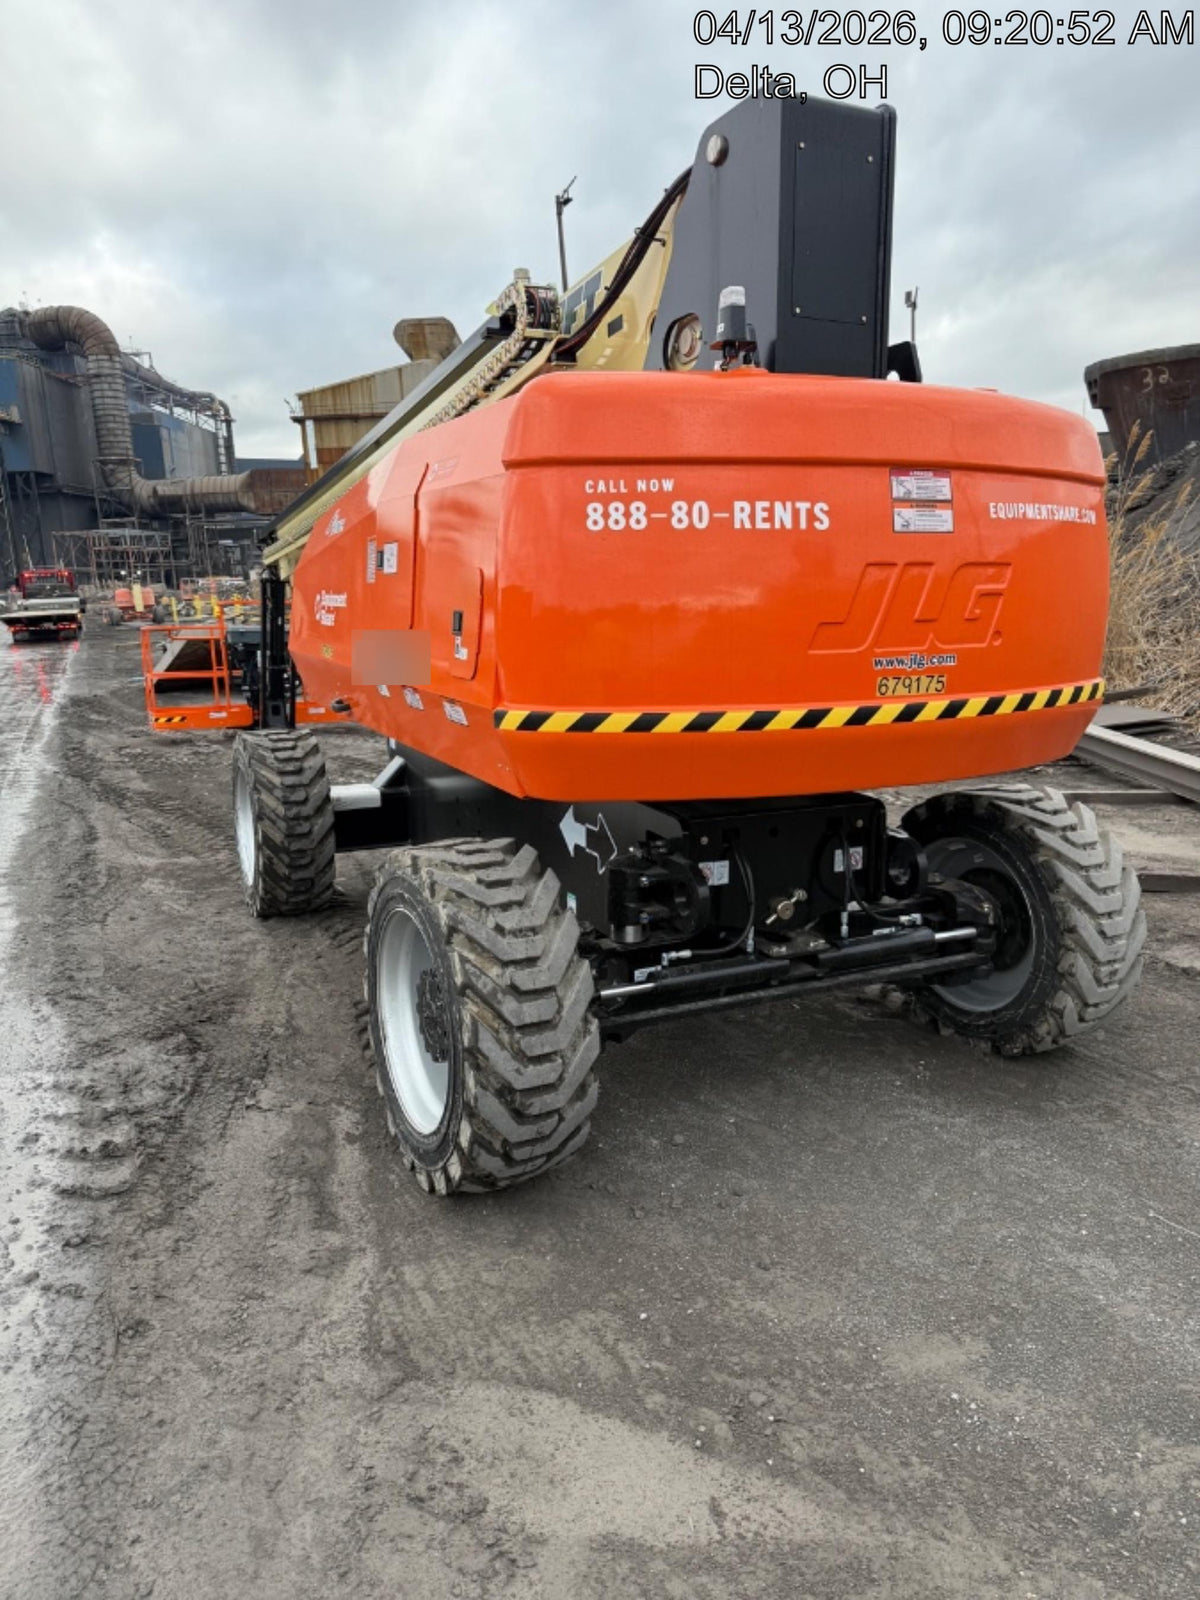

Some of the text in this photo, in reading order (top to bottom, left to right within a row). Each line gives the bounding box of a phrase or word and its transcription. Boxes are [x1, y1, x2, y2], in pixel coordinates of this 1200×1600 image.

[585, 478, 675, 494] CALL NOW
[586, 500, 831, 531] 888-80-RENTS
[808, 562, 1012, 653] JLG
[873, 653, 957, 670] www.jlg.com
[878, 675, 945, 696] 679175
